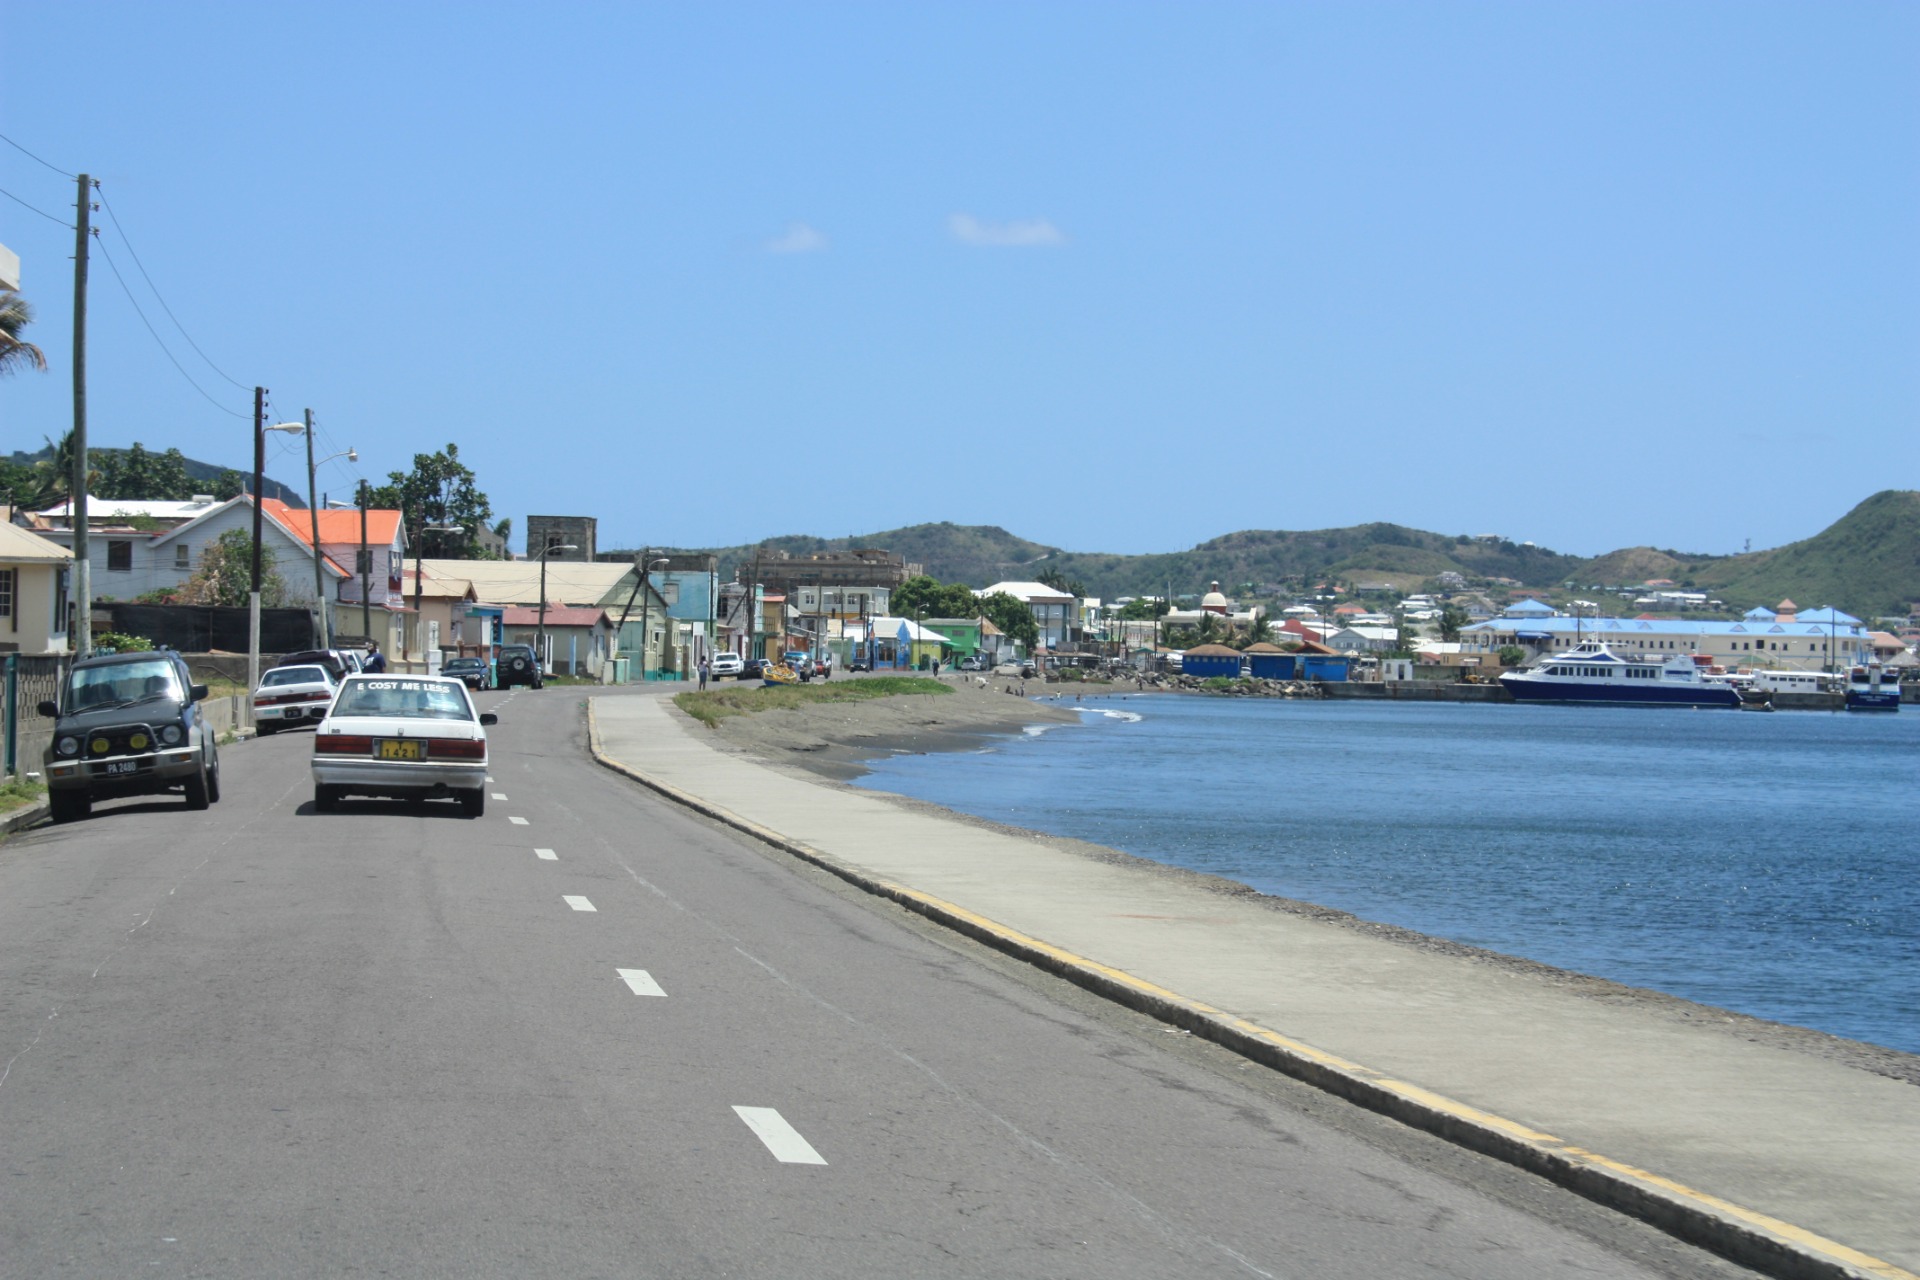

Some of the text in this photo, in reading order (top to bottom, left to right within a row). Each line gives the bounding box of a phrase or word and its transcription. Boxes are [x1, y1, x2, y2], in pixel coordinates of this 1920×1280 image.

[368, 681, 398, 690] COST
[401, 682, 420, 691] ME
[423, 683, 450, 694] LESS
[385, 748, 416, 758] 1421
[108, 763, 118, 773] PA
